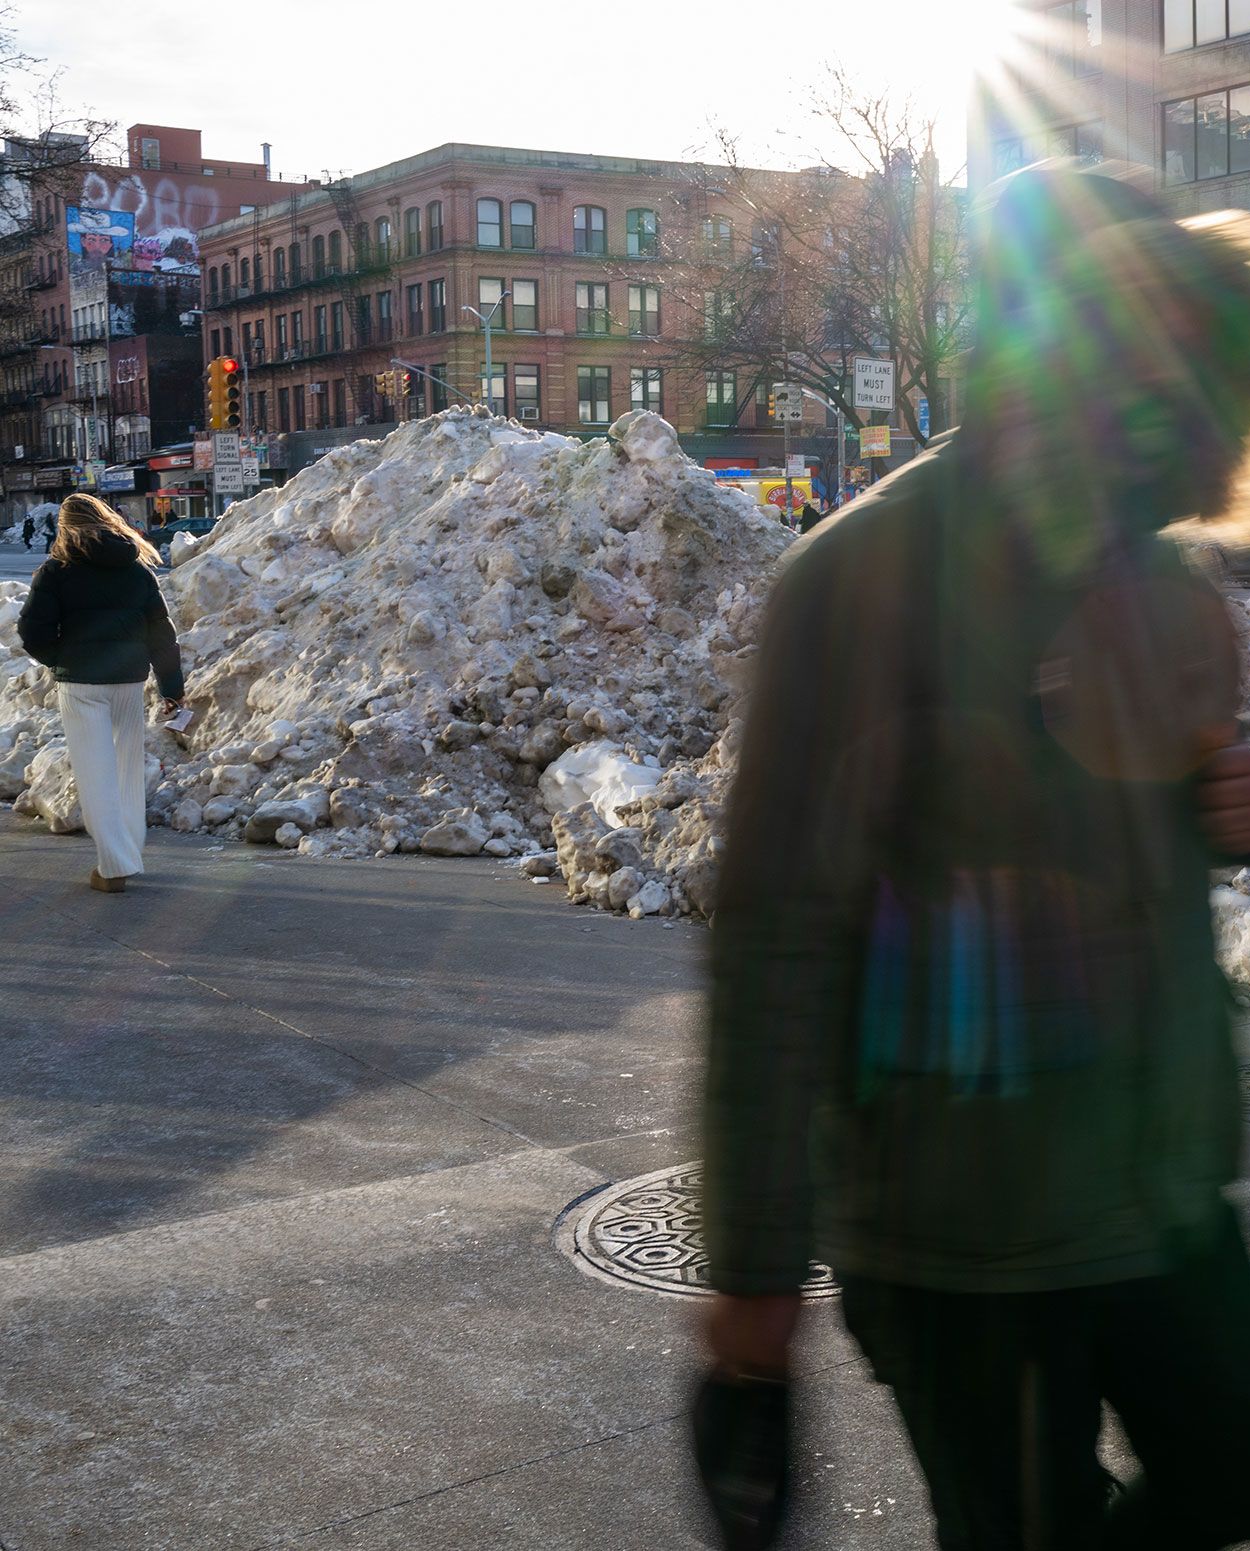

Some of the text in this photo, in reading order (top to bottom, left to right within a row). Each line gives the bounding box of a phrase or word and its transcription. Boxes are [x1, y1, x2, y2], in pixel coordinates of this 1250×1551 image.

[858, 364, 891, 375] LEFT LANE
[863, 379, 884, 390] MUST
[857, 393, 891, 404] TURN LEFT
[244, 468, 258, 477] 25
